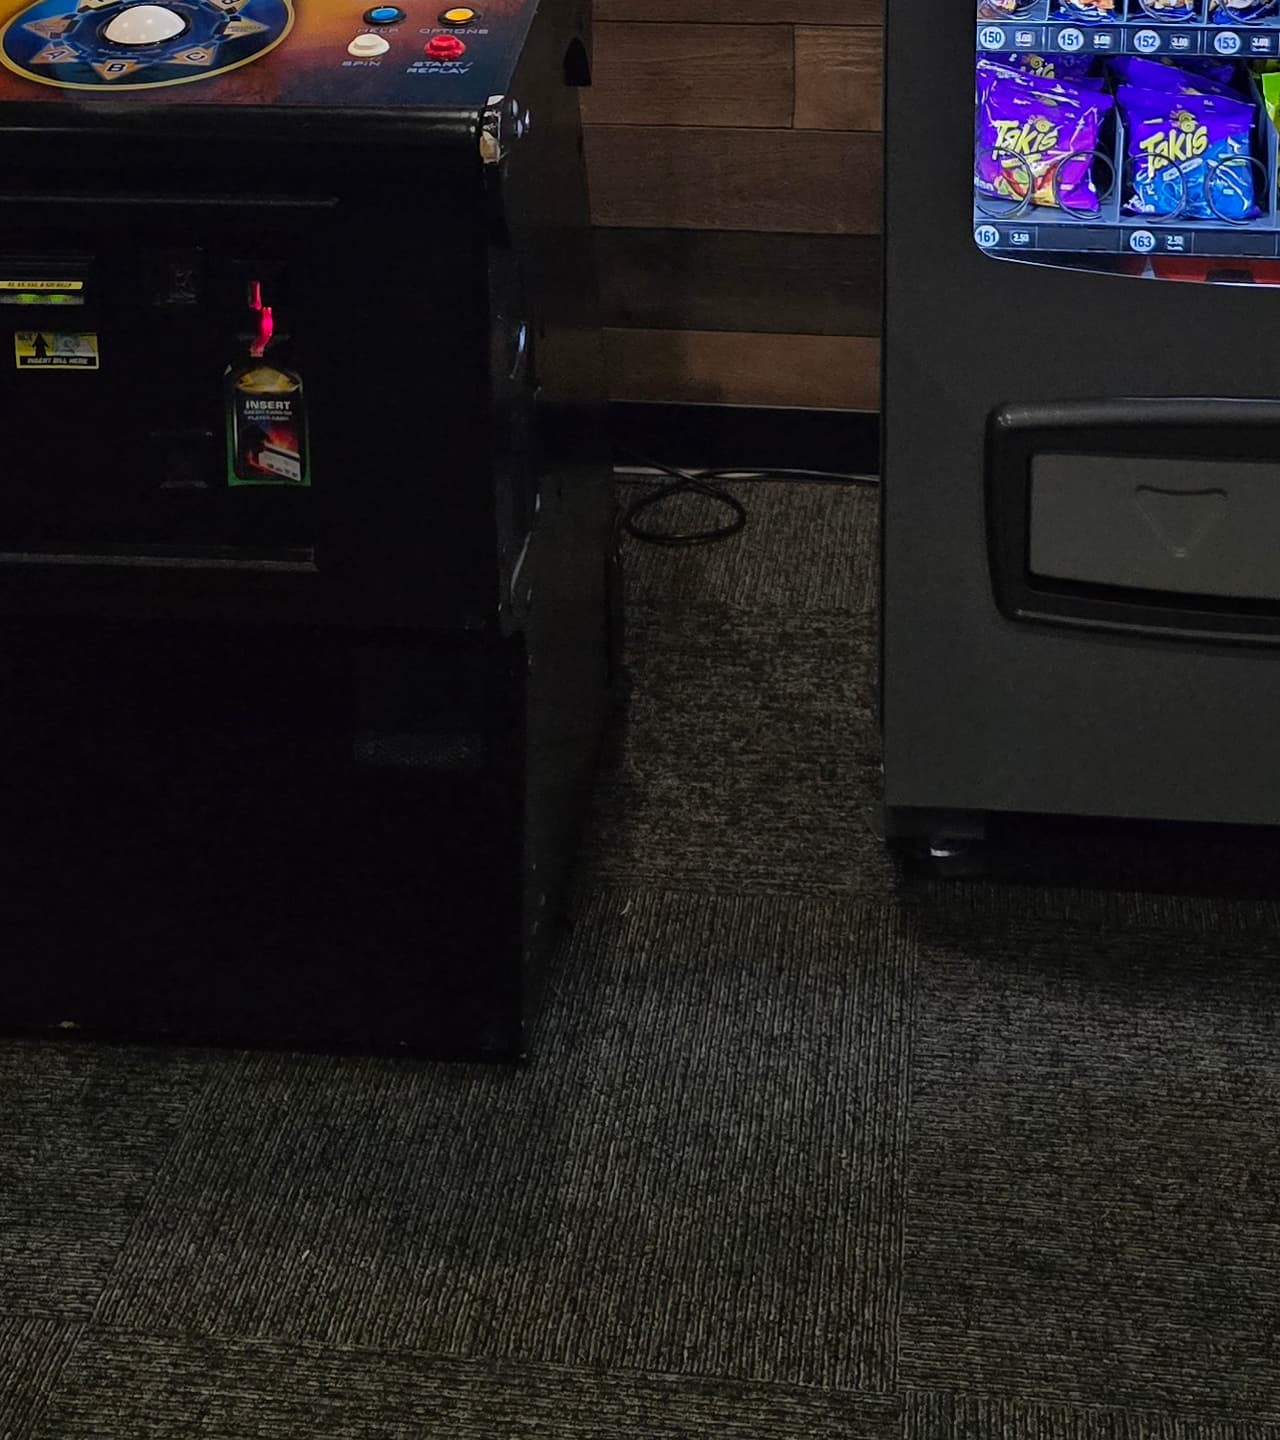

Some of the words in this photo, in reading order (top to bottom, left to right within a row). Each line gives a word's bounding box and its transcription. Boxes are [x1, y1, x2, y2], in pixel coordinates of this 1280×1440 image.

[981, 31, 1003, 46] 150
[1060, 33, 1081, 48] 151
[1135, 34, 1158, 49] 152
[1216, 36, 1238, 51] 153
[46, 49, 68, 61] A
[106, 62, 125, 73] B
[991, 118, 1059, 160] Takis
[1140, 125, 1209, 180] Takis
[976, 230, 998, 245] 161
[1132, 234, 1153, 249] 163
[245, 400, 291, 410] INSERT
